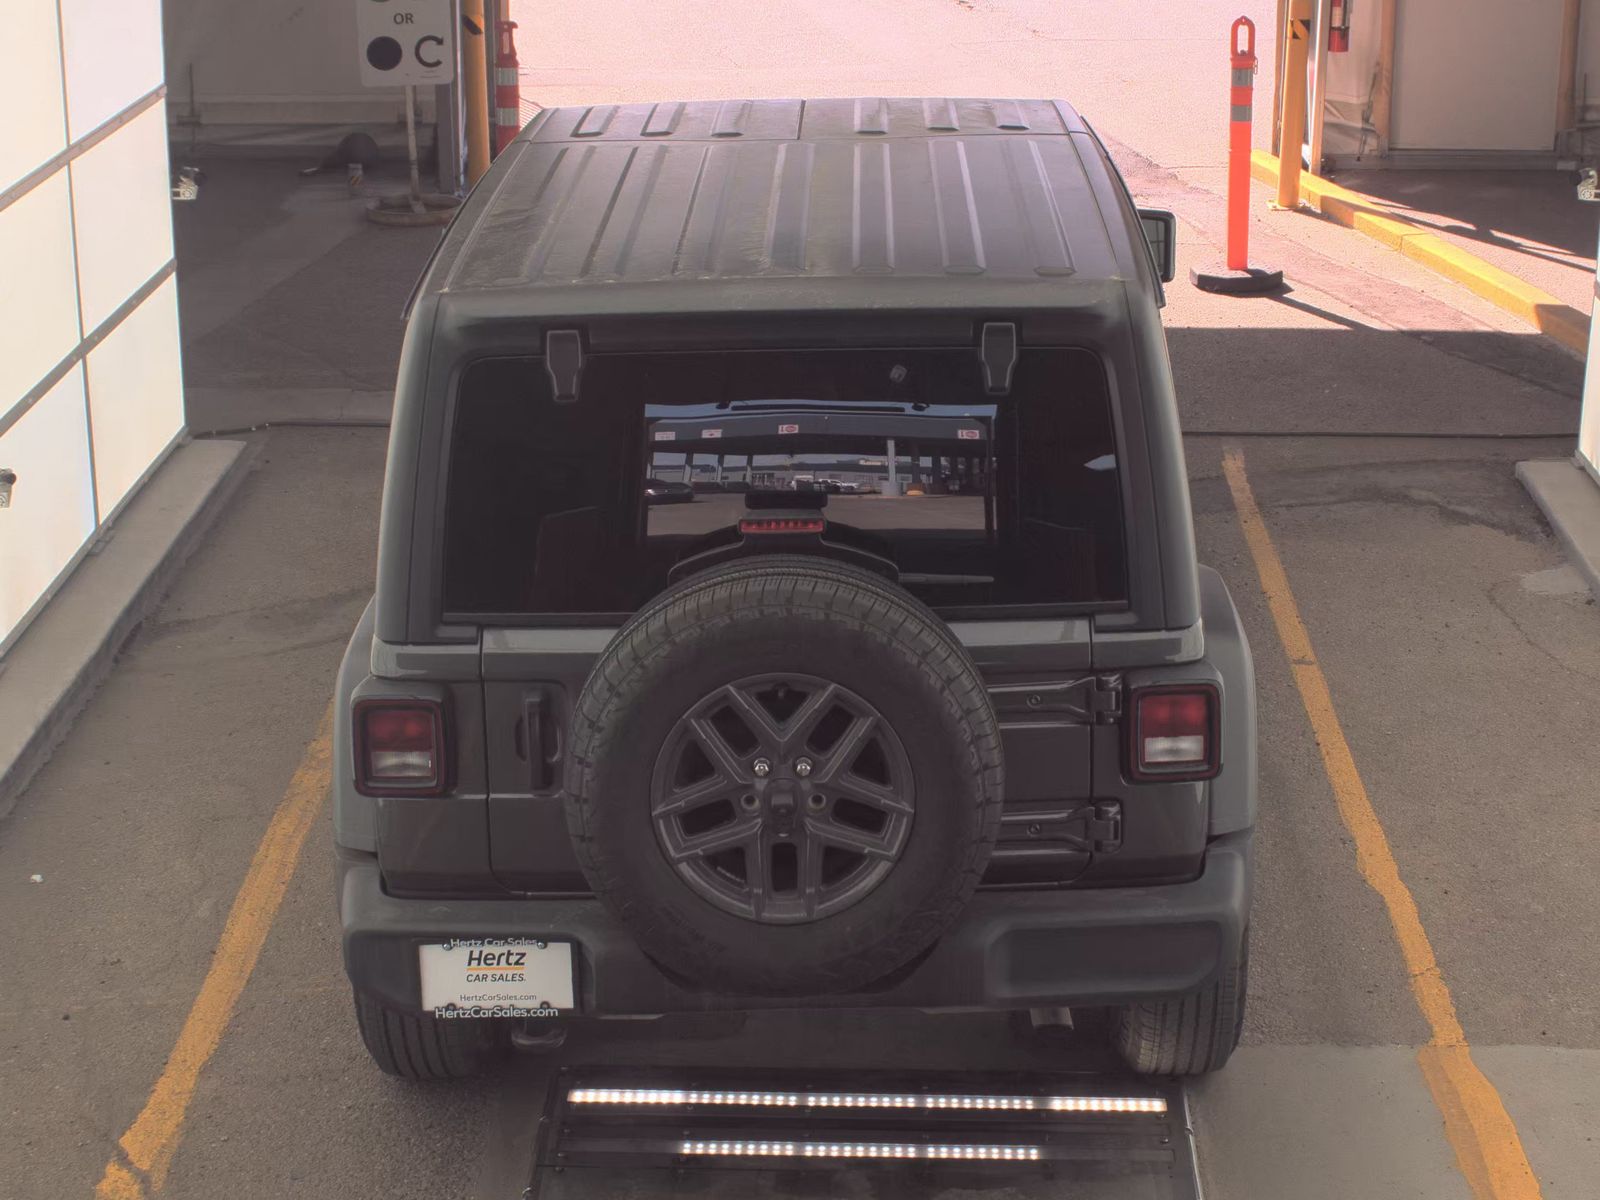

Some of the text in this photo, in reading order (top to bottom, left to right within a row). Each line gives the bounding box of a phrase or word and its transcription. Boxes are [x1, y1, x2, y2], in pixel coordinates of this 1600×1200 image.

[393, 13, 414, 25] OR
[450, 937, 537, 948] Hertz Car Sales
[467, 949, 527, 967] Hertz
[466, 973, 488, 983] CAR
[460, 993, 537, 1002] HertzCarSales.com
[435, 1005, 559, 1019] HertzCarSales.com
